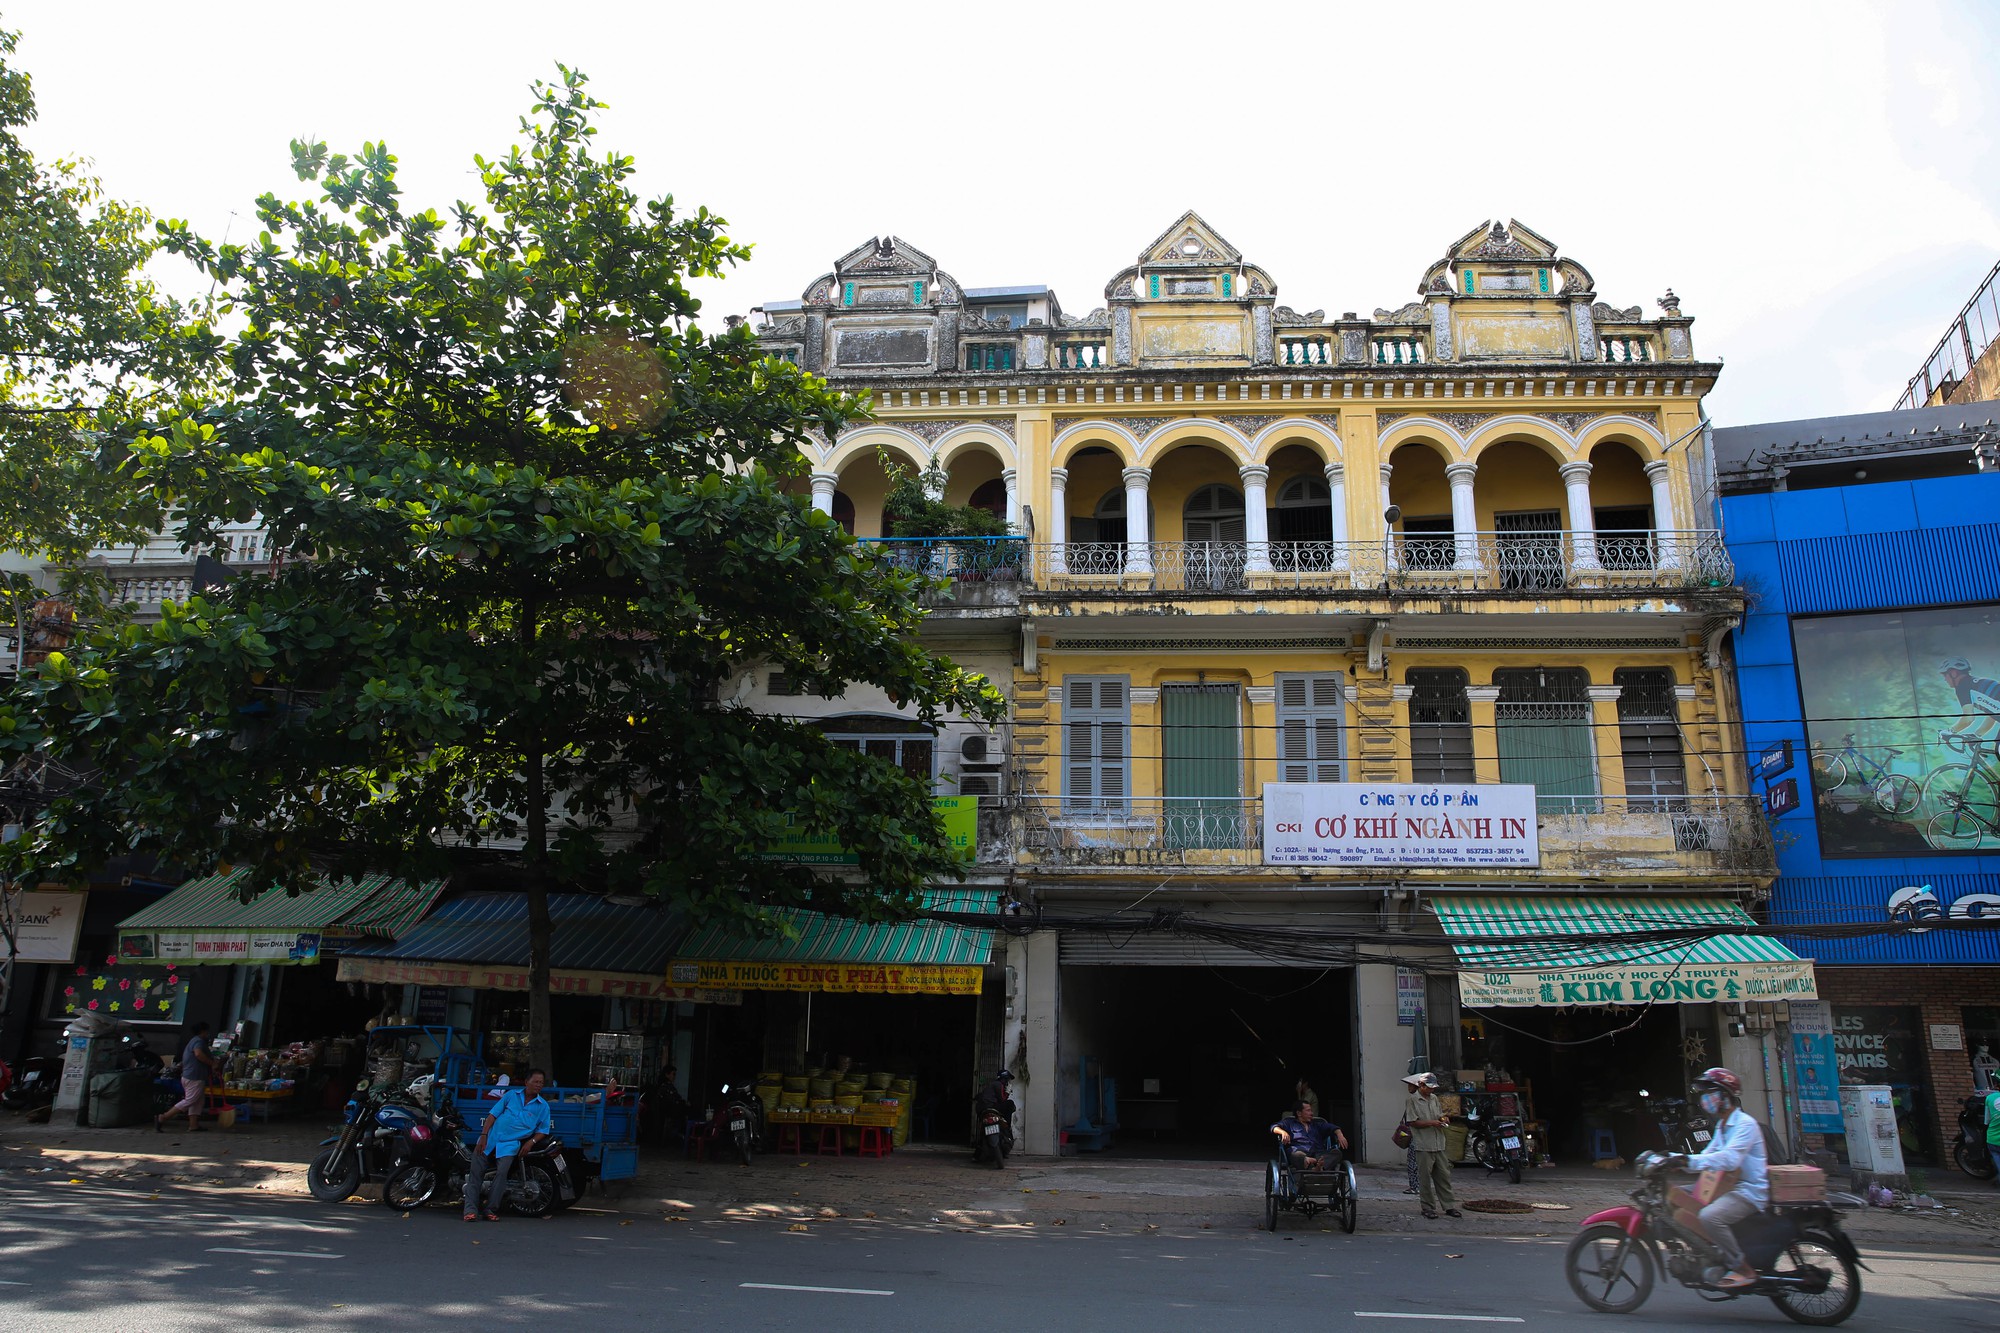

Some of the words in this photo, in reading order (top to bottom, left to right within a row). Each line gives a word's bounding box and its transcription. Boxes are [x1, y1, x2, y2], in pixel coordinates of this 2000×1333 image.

[1766, 749, 1783, 765] GIANT
[1360, 792, 1394, 806] CNG
[1421, 788, 1439, 806] CỔ
[1771, 788, 1786, 809] Liv
[1276, 823, 1302, 833] CKI
[1314, 815, 1347, 839] CƠ
[1353, 812, 1398, 839] KHÍ
[1405, 812, 1492, 839] NGÀNH
[1500, 818, 1526, 839] IN
[482, 972, 589, 993] THNH
[700, 963, 728, 980] NHÀ
[733, 964, 779, 981] THUỐC
[784, 965, 841, 983] TÙNG
[846, 964, 904, 984] PHÁT
[1483, 974, 1511, 985] 102A
[1631, 971, 1658, 980] HỌC
[1538, 983, 1558, 1002] 龍
[1561, 981, 1624, 1002] KIM
[1630, 979, 1719, 1001] LONG
[1723, 978, 1743, 999] 金
[1745, 977, 1765, 997] DƯỢC
[1765, 975, 1782, 996] LIỆU
[1783, 978, 1799, 993] NAM
[1799, 971, 1815, 993] BẮC
[1832, 1015, 1865, 1030] LES
[1834, 1034, 1885, 1049] RVICE
[1836, 1053, 1889, 1068] PAIRS
